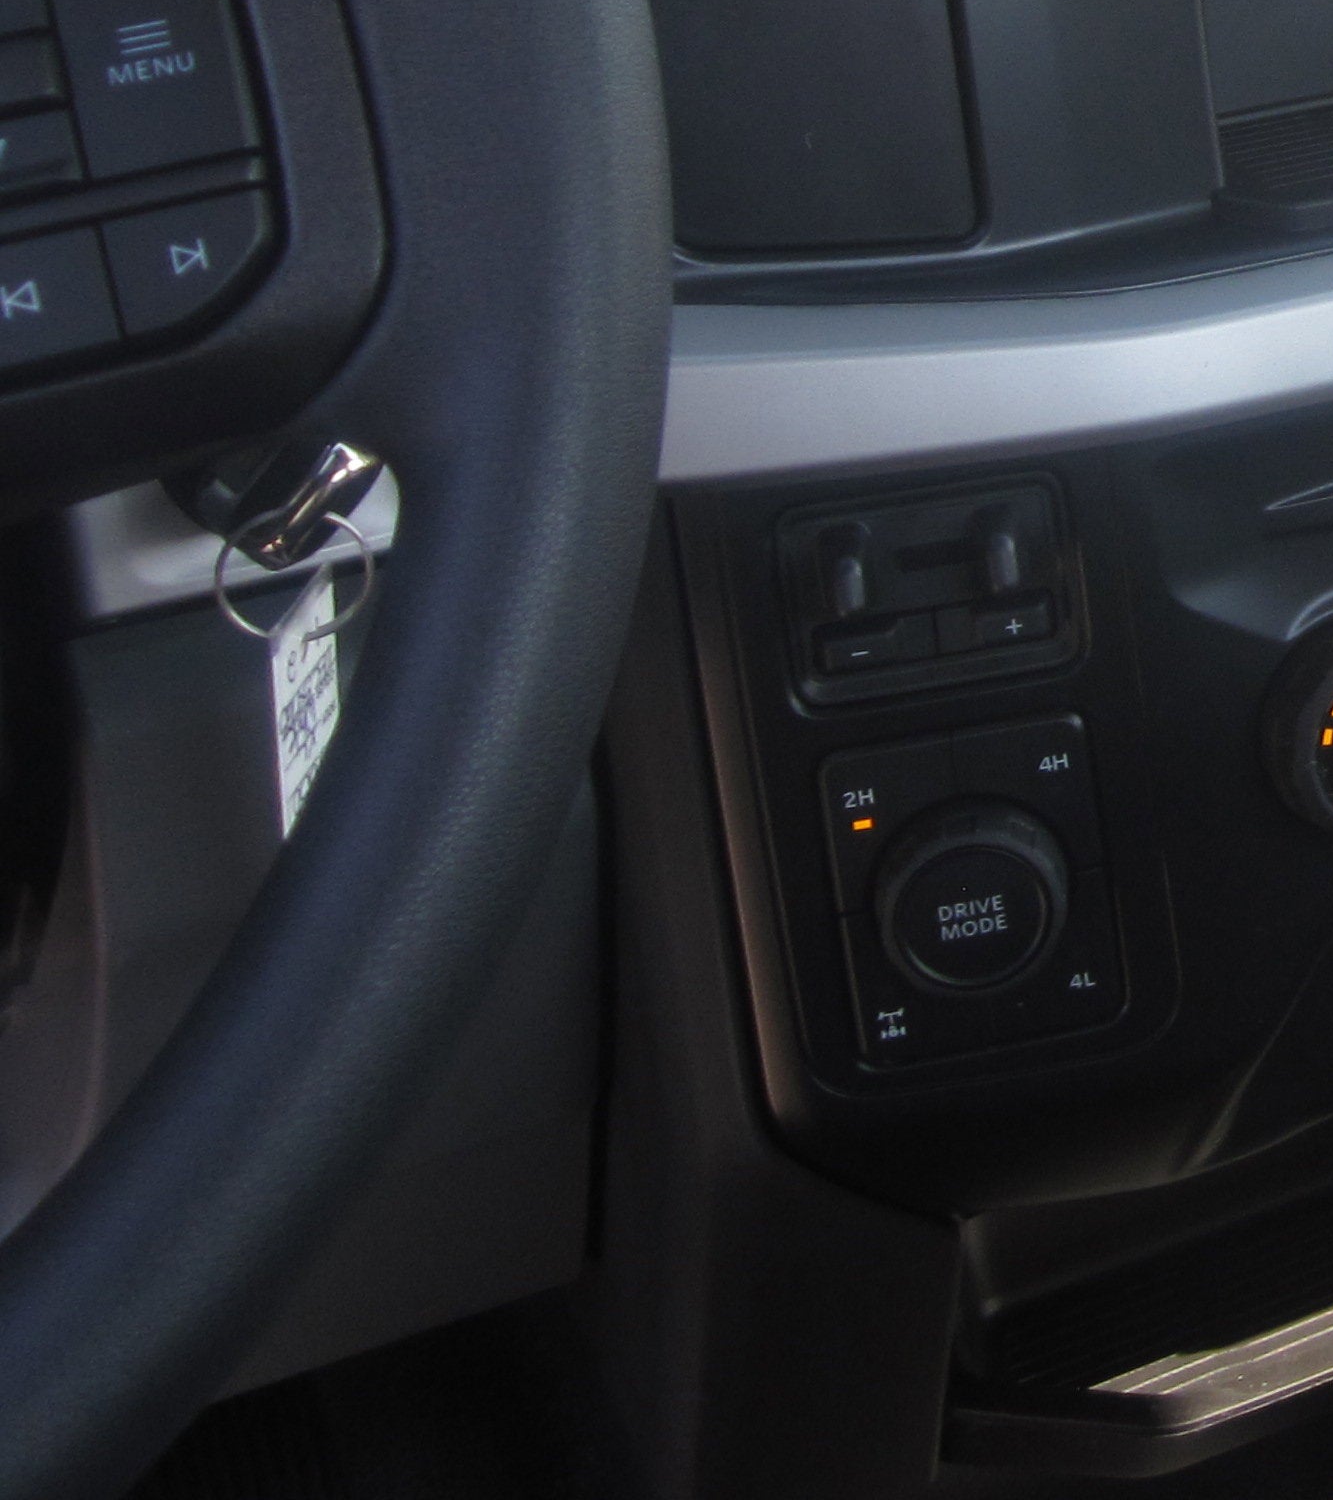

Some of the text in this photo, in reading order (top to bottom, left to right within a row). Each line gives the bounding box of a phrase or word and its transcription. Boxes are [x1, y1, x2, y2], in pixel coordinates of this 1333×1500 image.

[107, 52, 196, 86] MENU
[1038, 753, 1070, 773] 4H
[843, 788, 875, 810] 2H
[937, 894, 1005, 922] DRIVE
[940, 914, 1008, 941] MODE
[1069, 972, 1096, 989] 4L
